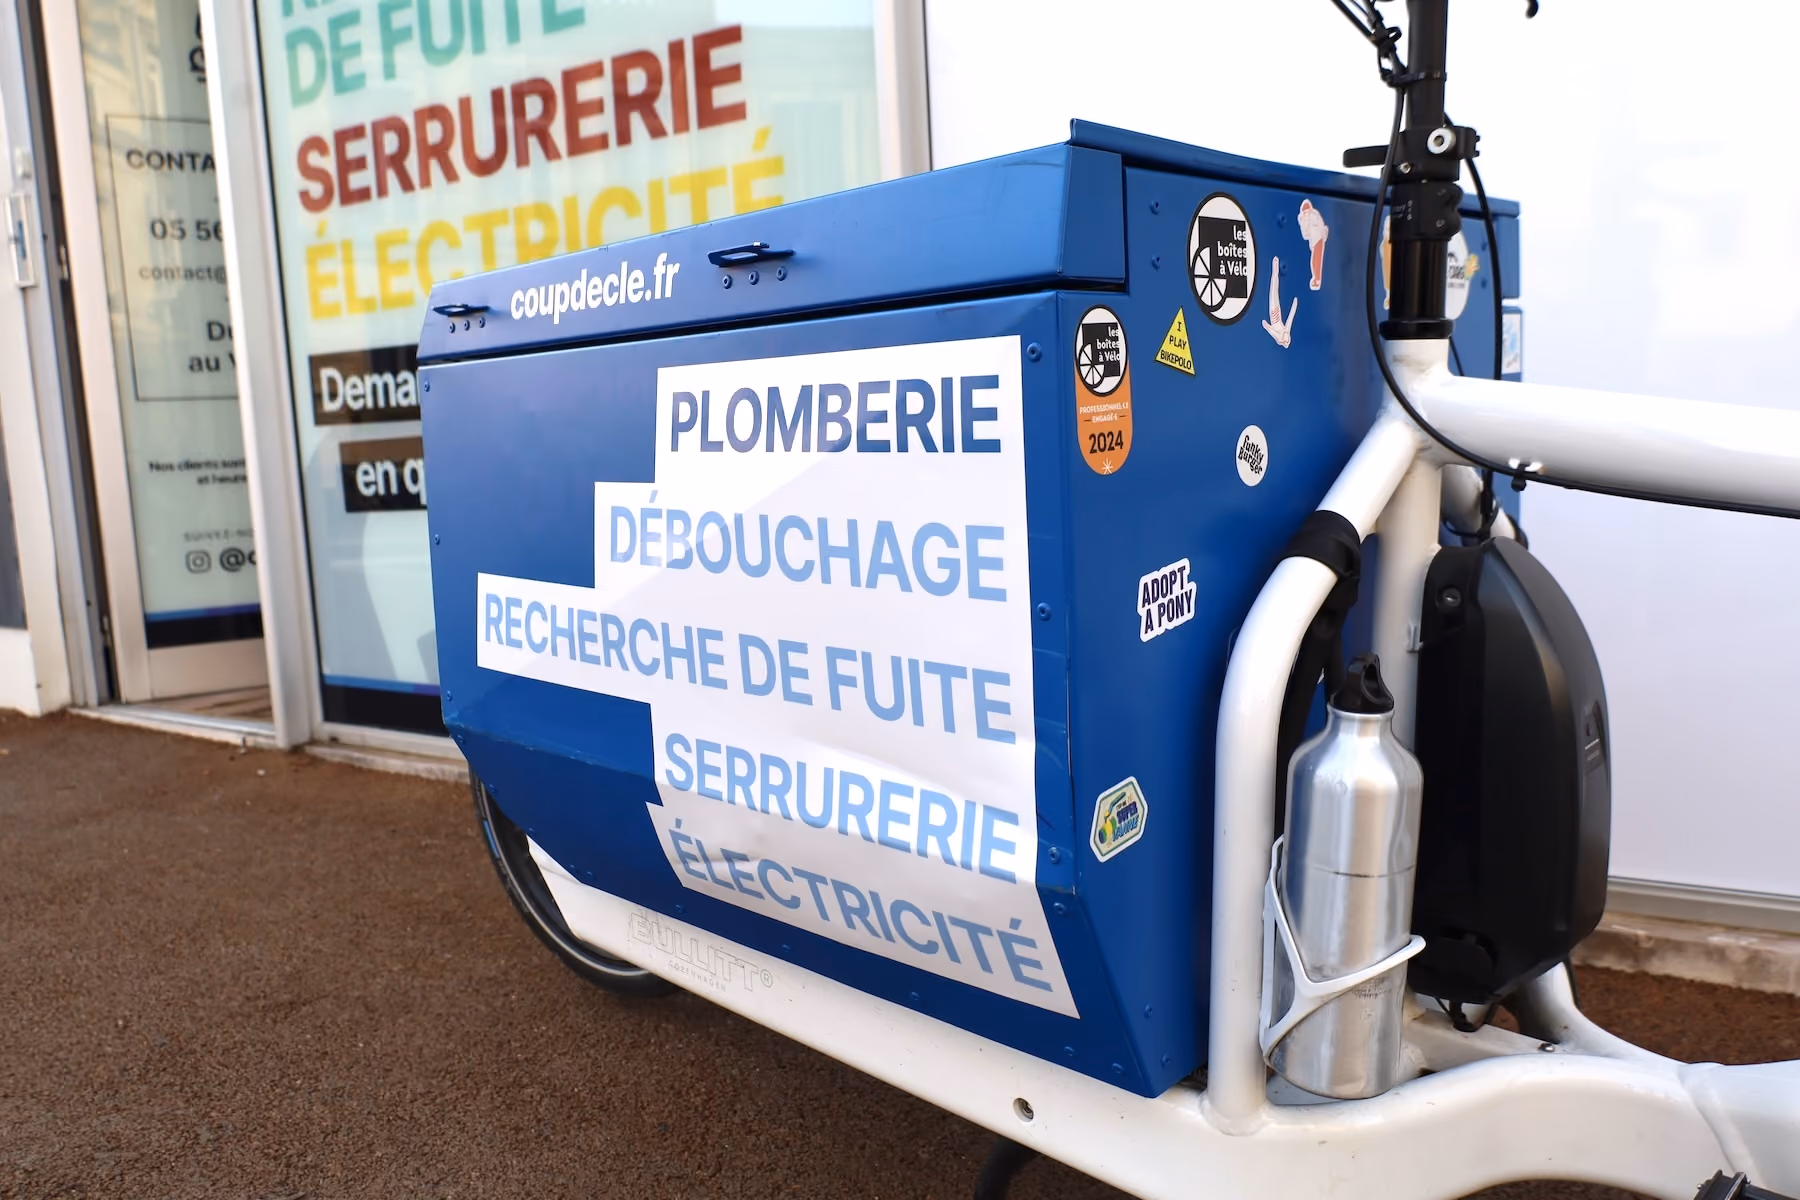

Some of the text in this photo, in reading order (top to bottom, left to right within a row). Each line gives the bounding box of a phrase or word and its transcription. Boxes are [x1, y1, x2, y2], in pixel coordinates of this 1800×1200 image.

[285, 9, 366, 108] DE
[297, 23, 747, 214] SERRURERIE
[151, 219, 187, 241] 05
[1233, 225, 1247, 241] les
[511, 252, 680, 325] coupdecle.fr
[189, 356, 220, 373] au
[1160, 349, 1192, 370] BIKEPOLO
[1169, 334, 1187, 350] PLAY
[319, 367, 420, 412] Dema
[671, 374, 1002, 454] PLOMBERIE
[1088, 429, 1124, 454] 2024
[356, 458, 398, 497] en
[610, 489, 1008, 602] DÉBOUCHAGE
[1141, 565, 1186, 609] ADOPT
[1144, 588, 1193, 635] A PONY
[484, 592, 1016, 745] RECHERCHE DE FUITE
[664, 732, 1019, 885] SERRURERIE
[668, 818, 1054, 994] ÉLECTRICITÉ
